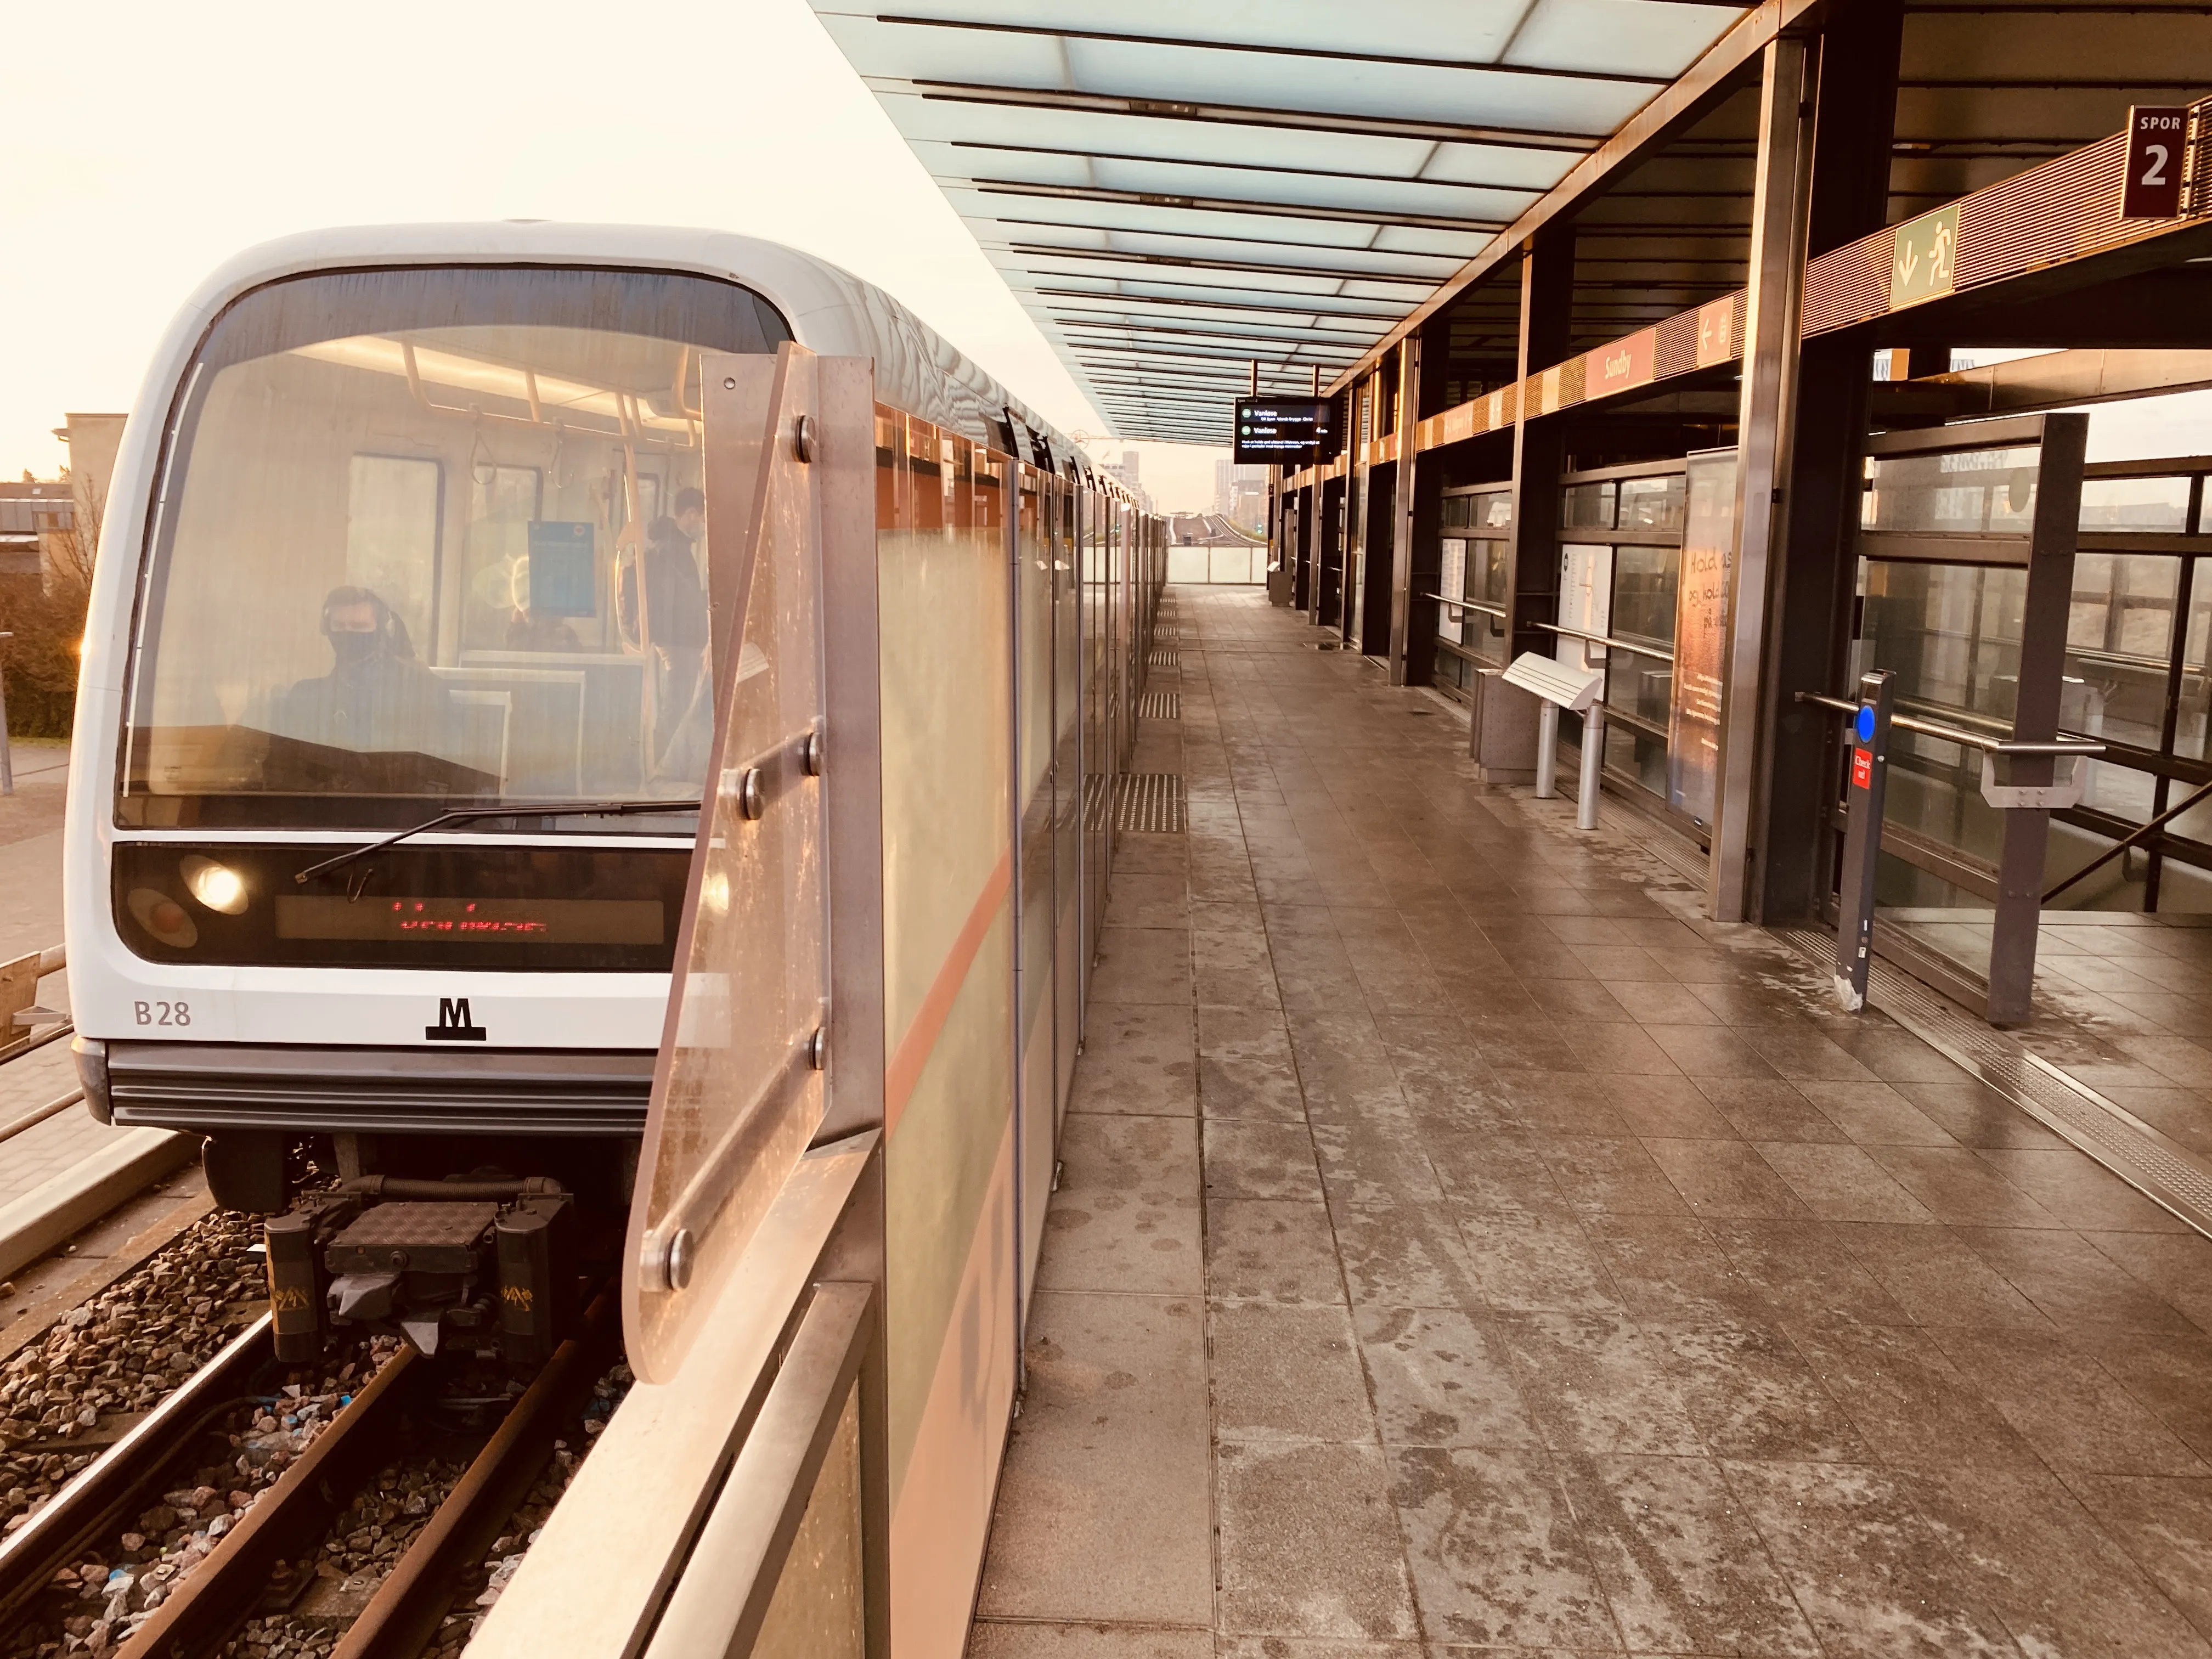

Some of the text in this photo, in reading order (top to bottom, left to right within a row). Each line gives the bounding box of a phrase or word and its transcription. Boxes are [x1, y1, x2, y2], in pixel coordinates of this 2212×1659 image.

[2140, 117, 2181, 129] SPOR
[2141, 144, 2168, 185] 2
[1605, 349, 1632, 380] Sundby
[1691, 547, 1717, 573] Hold
[1855, 755, 1871, 770] Check
[134, 1001, 191, 1026] B28
